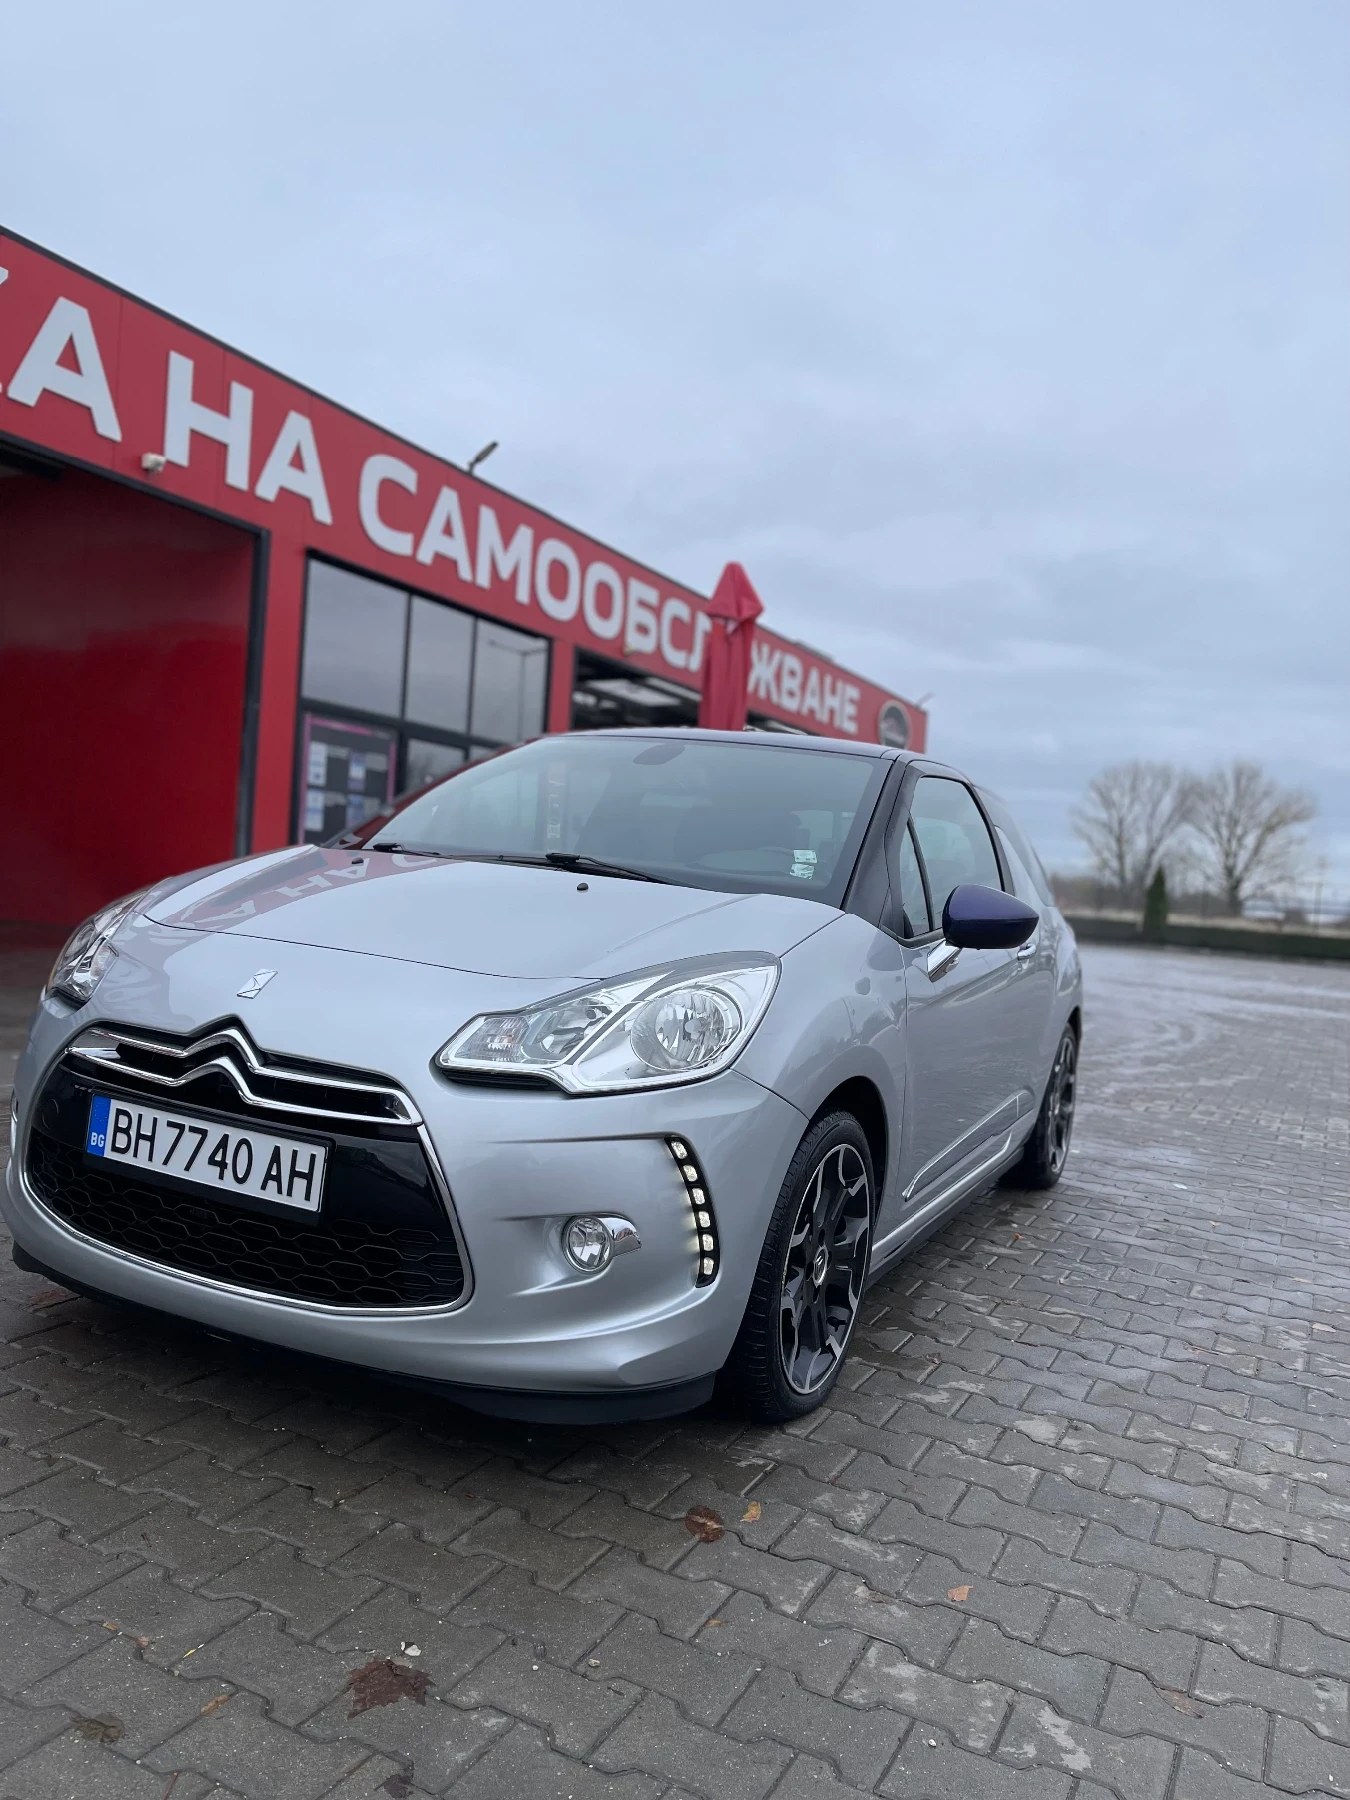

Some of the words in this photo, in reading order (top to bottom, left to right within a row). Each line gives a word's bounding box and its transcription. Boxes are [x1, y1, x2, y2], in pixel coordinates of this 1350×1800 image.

[0, 267, 122, 442] А
[164, 350, 333, 525] НА
[358, 453, 860, 733] САМООБСЛЖВАНЕ
[91, 1132, 105, 1147] BG
[162, 1120, 252, 1184] 7740
[260, 1145, 316, 1201] AH
